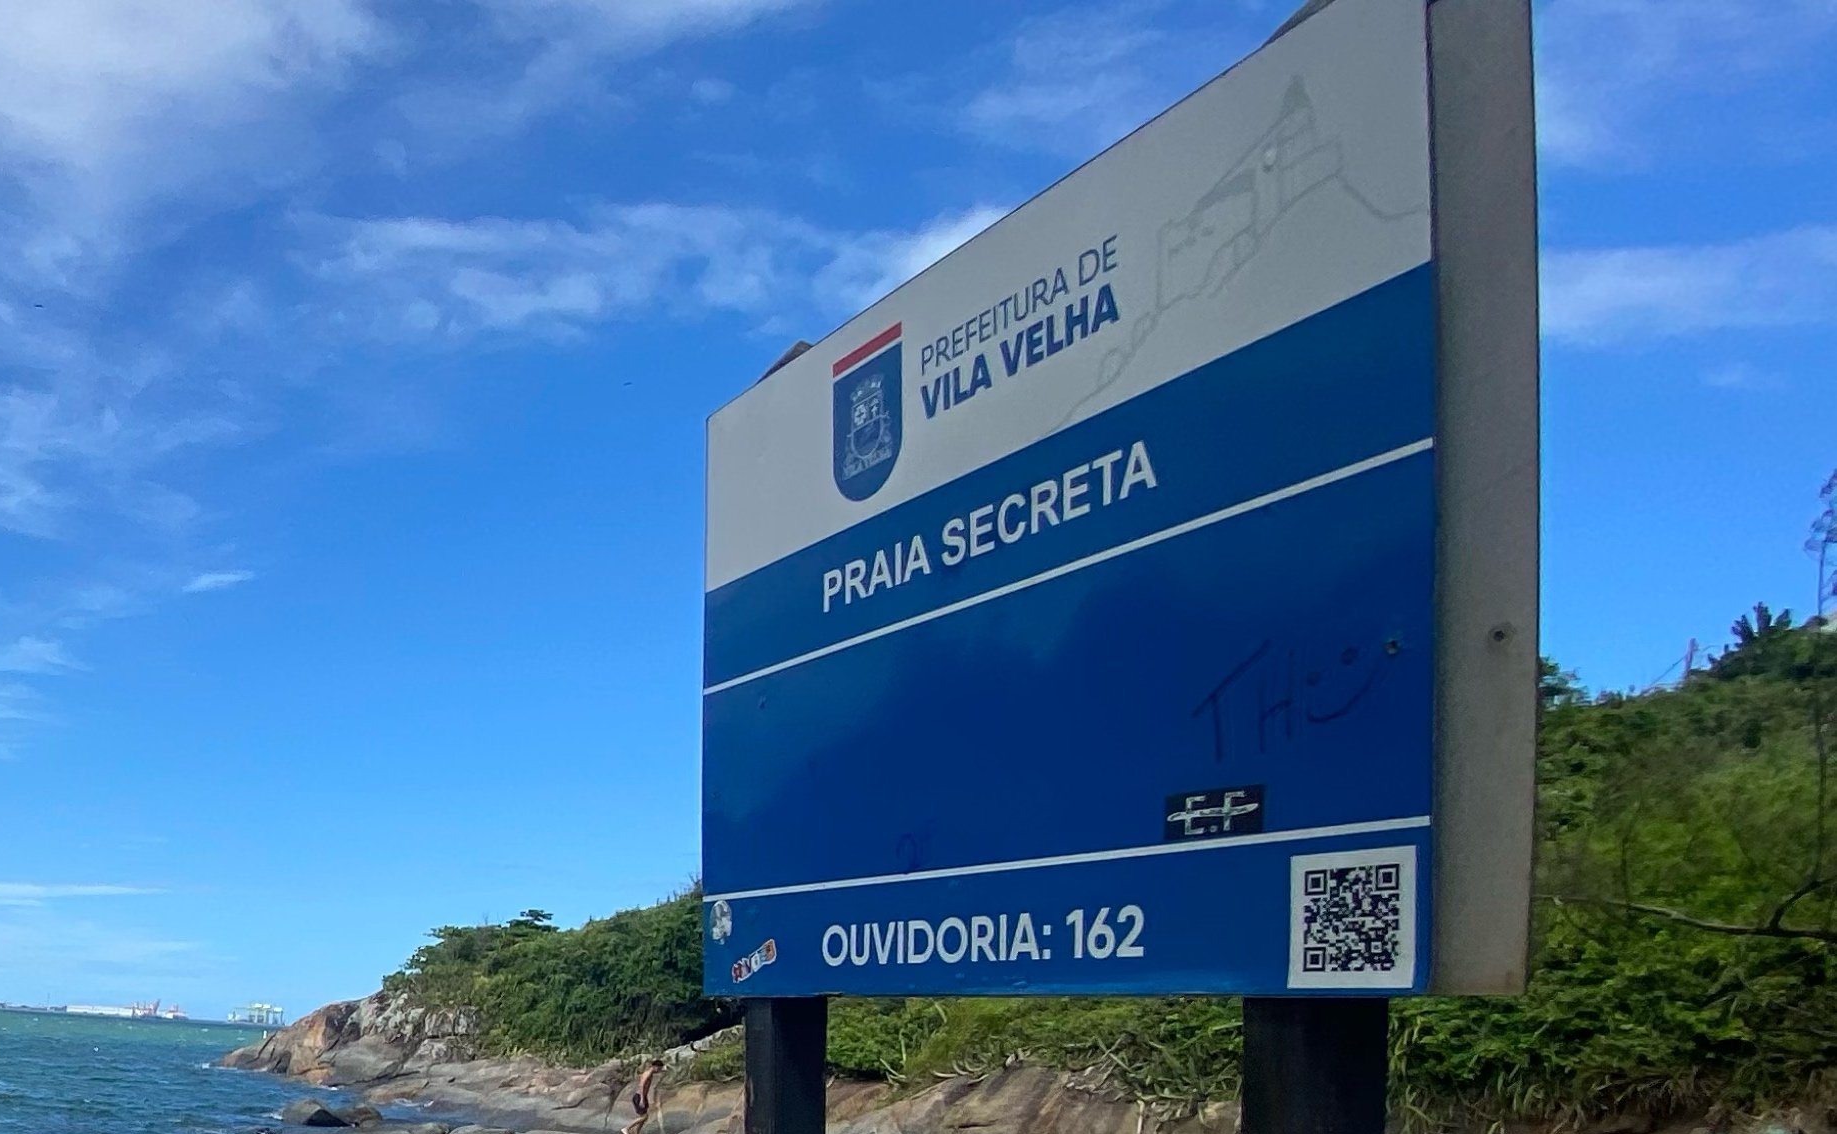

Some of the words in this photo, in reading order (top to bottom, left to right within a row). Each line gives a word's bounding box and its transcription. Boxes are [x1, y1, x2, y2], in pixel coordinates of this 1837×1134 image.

[920, 353, 993, 420] VILA
[999, 282, 1120, 378] VELHA
[921, 267, 1070, 376] PREFEITURA
[1078, 234, 1118, 287] DE
[823, 535, 931, 613] PRAIA
[941, 439, 1157, 566] SECRETA
[822, 912, 1051, 967] OUVIDORIA:
[1066, 904, 1145, 960] 162
